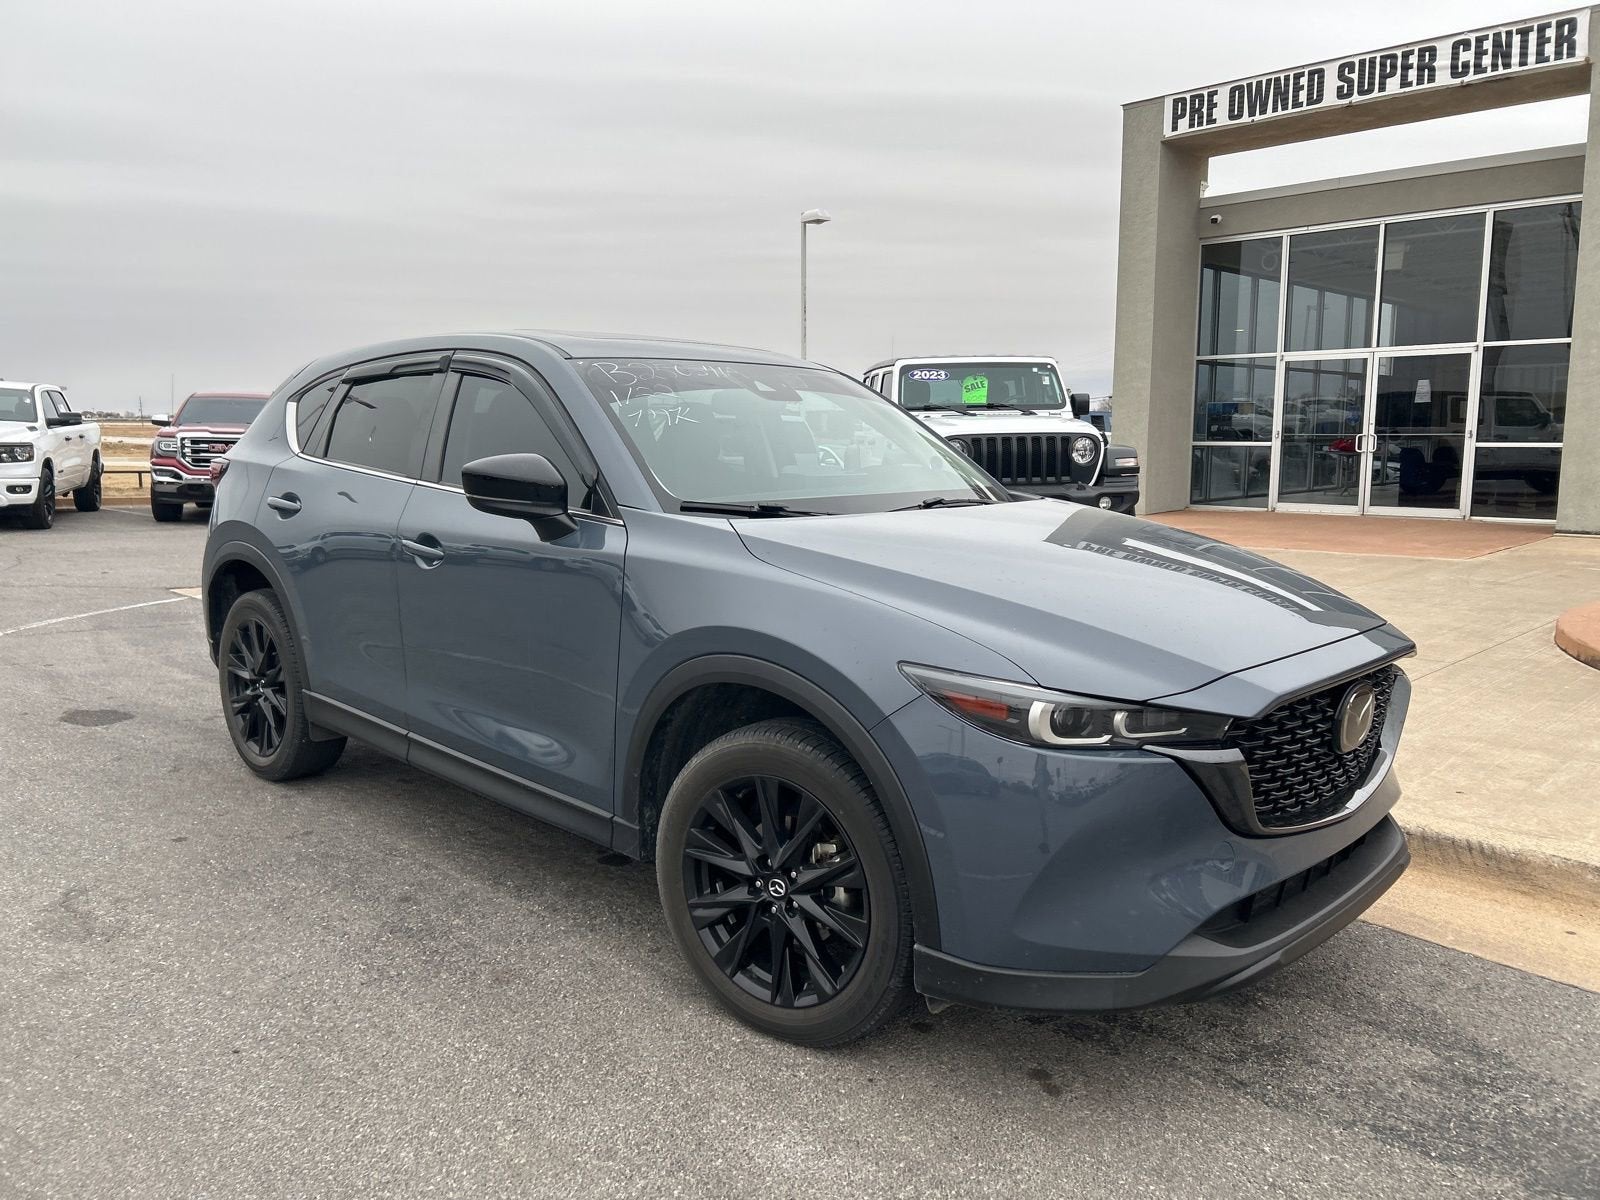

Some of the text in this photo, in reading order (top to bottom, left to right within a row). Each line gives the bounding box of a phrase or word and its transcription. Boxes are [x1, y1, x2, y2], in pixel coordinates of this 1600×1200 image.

[1171, 17, 1578, 132] PRE OWNED SUPER CENTER
[913, 370, 946, 379] 2023
[964, 380, 986, 393] SALE
[209, 443, 234, 453] GM
